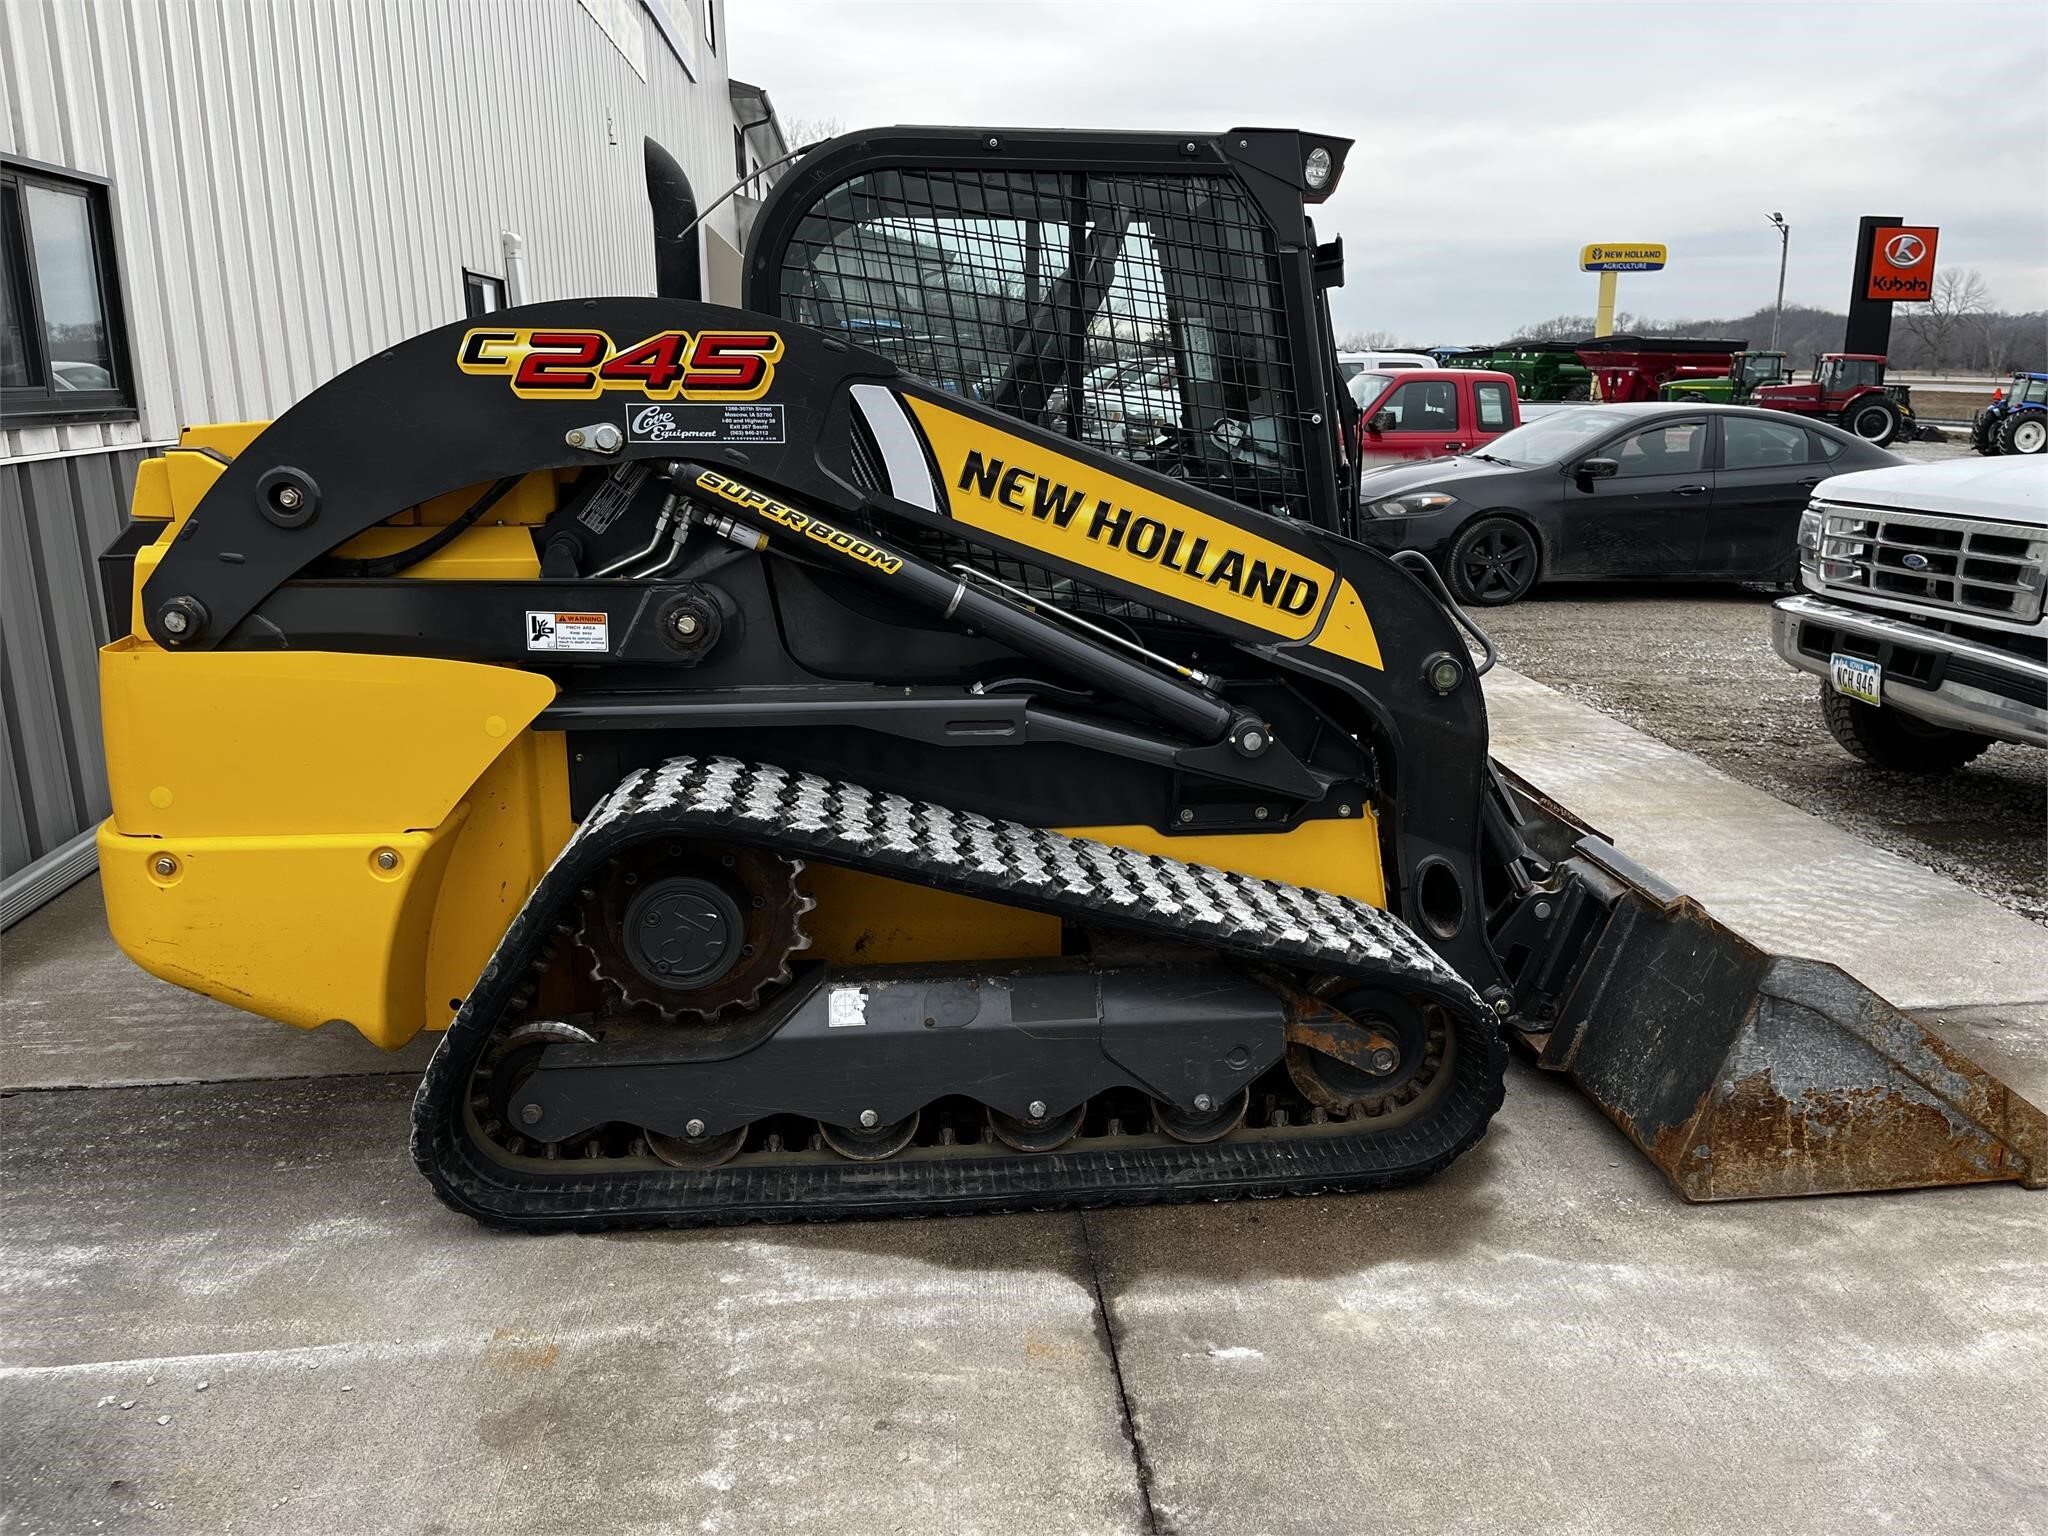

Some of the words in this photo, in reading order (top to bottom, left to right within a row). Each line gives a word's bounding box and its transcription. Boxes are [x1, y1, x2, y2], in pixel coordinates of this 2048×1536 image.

[1602, 262, 1647, 270] AGRICULTURE
[1604, 250, 1622, 259] NEW
[1624, 250, 1661, 259] HOLLAND
[1872, 275, 1928, 292] Kubota
[632, 405, 674, 434] Cove
[650, 423, 717, 441] Equipment
[696, 470, 809, 532] SUPER
[805, 520, 903, 575] BOOM
[957, 449, 1086, 529] NEW
[1086, 499, 1319, 616] HOLLAND
[1837, 667, 1854, 689] NCH
[1856, 672, 1874, 695] 946
